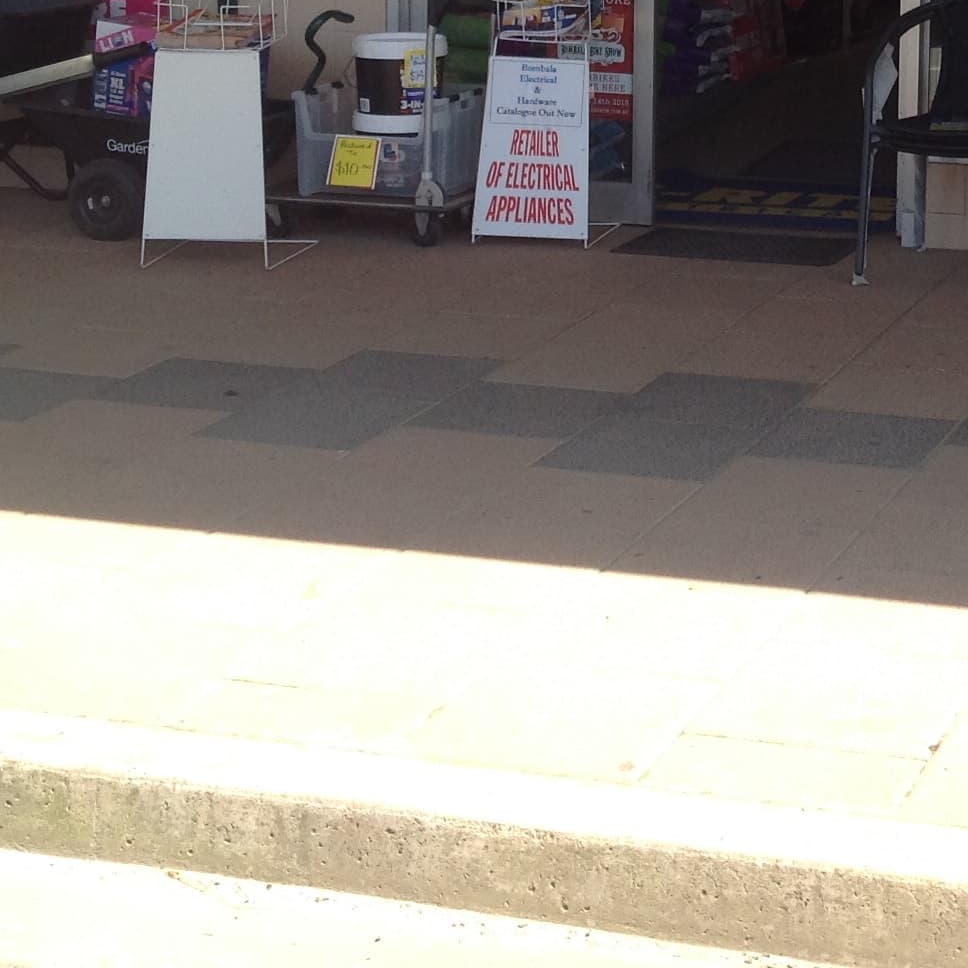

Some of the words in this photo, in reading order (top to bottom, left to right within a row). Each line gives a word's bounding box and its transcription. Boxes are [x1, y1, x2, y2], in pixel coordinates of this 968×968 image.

[521, 63, 557, 73] Bombala
[519, 74, 557, 84] Electrical
[533, 86, 541, 94] &
[516, 96, 557, 106] Hardware
[496, 106, 537, 118] Catalogue
[538, 108, 555, 117] Out
[556, 109, 576, 118] Now
[510, 128, 560, 158] RETAILER
[486, 160, 506, 188] OF
[505, 161, 580, 192] ELECTRICAL
[485, 195, 575, 226] APPLIANCES
